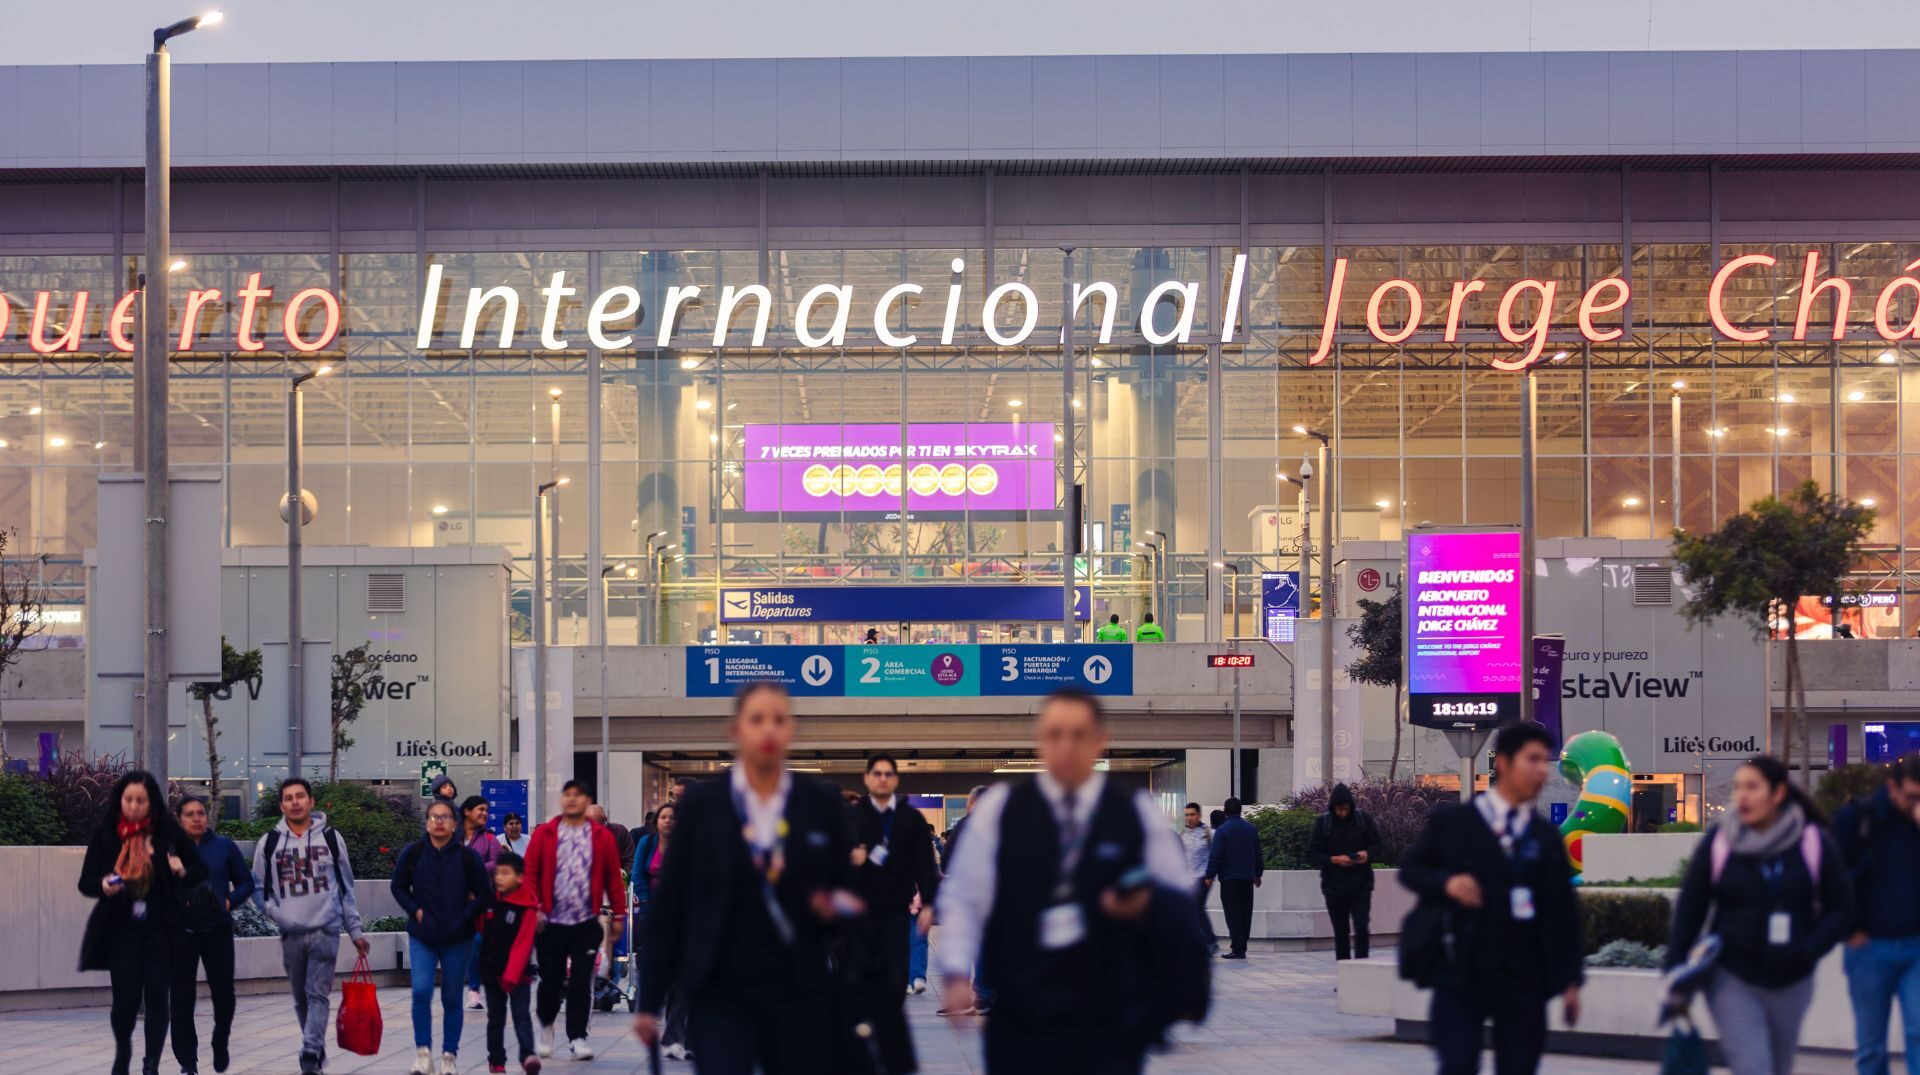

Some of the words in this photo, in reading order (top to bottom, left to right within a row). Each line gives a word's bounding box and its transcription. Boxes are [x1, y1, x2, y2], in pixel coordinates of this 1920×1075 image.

[417, 254, 1247, 350] Internacional
[1309, 258, 1631, 371] Jorge
[761, 447, 767, 458] 7
[772, 446, 811, 458] VECES
[813, 446, 887, 457] PREMIADOS
[919, 446, 930, 456] TI
[932, 446, 950, 456] EN
[954, 445, 1038, 456] SKYTRAX
[1281, 517, 1293, 525] LG
[1418, 569, 1514, 584] BIENVENIDOS
[753, 591, 794, 604] Salidas
[1417, 589, 1490, 602] AEROPUERTO
[752, 604, 812, 618] Departures
[1417, 604, 1508, 616] INTERNACIONAL
[1417, 619, 1454, 634] JORGE
[1454, 616, 1499, 631] CHÁVEZ
[368, 650, 418, 663] océano
[1592, 652, 1600, 663] y
[1604, 651, 1648, 663] pureza
[704, 657, 720, 684] 1
[859, 657, 881, 684] 2
[884, 660, 904, 668] ÁREA
[1001, 656, 1019, 681] 3
[1432, 702, 1498, 716] 18:10:19
[396, 740, 438, 757] Life's
[441, 740, 493, 757] Good.
[1663, 736, 1705, 753] Life's
[1708, 736, 1761, 753] Good.
